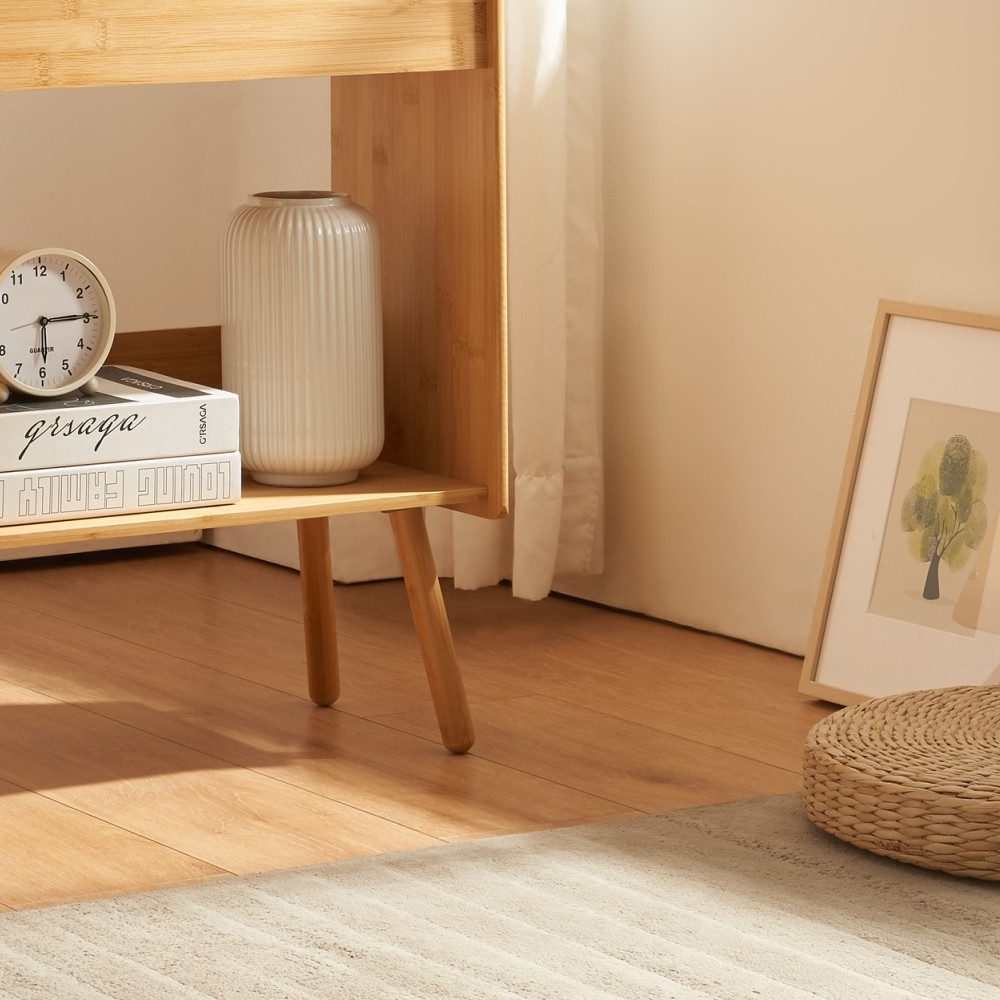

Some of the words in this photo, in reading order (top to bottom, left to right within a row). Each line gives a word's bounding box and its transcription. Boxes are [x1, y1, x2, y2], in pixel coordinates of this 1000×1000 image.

[33, 265, 47, 277] 12
[60, 270, 66, 281] 1
[11, 274, 23, 285] 11
[76, 288, 83, 299] 2
[83, 312, 90, 323] 3
[77, 338, 84, 349] 4
[0, 345, 6, 356] 8
[15, 363, 22, 374] 7
[62, 359, 69, 370] 5
[39, 367, 46, 378] 6
[18, 411, 147, 461] grsaga
[18, 470, 125, 516] FAMILY
